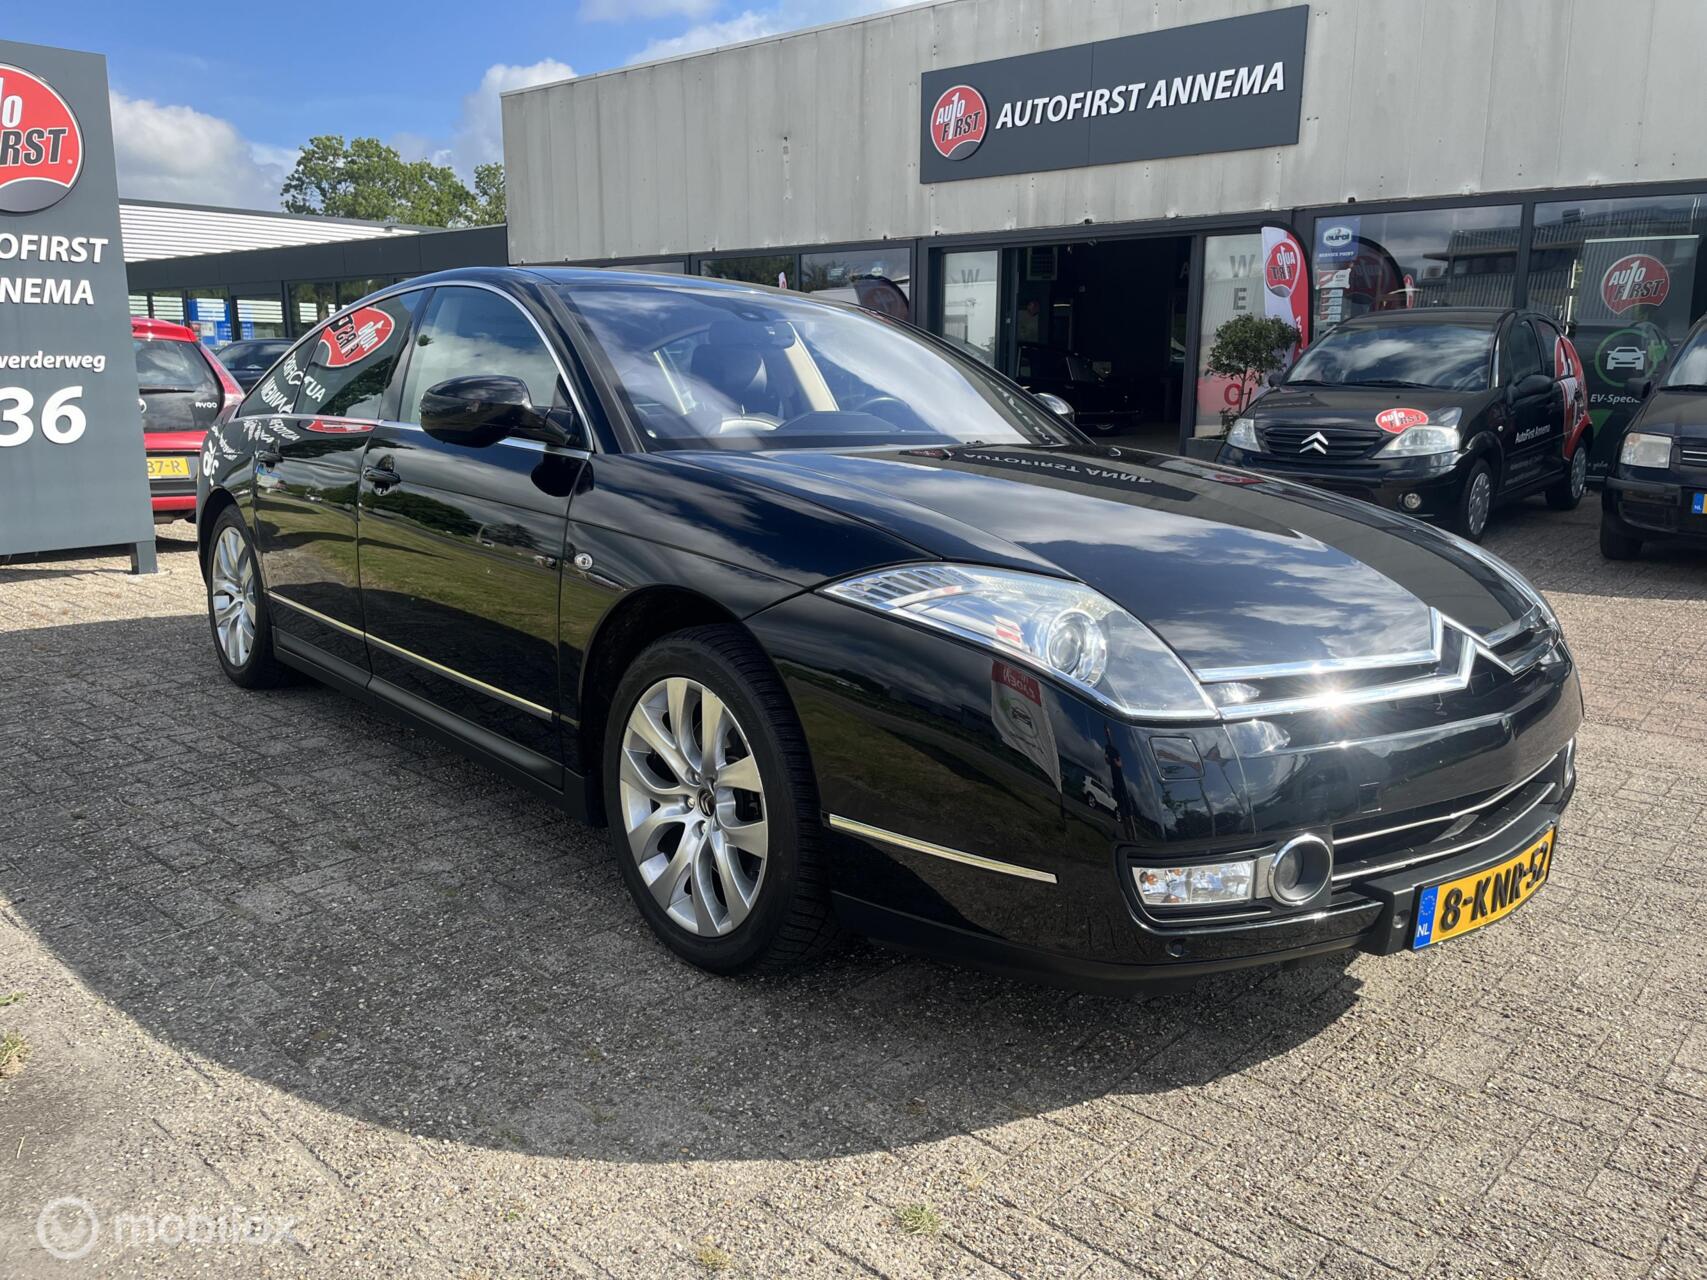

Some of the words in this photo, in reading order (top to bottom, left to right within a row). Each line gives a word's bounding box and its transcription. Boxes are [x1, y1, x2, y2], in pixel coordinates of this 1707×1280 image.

[995, 83, 1145, 129] AUTOFIRST
[1147, 61, 1285, 109] ANNEMA
[0, 385, 87, 447] 36
[1416, 923, 1430, 938] NL
